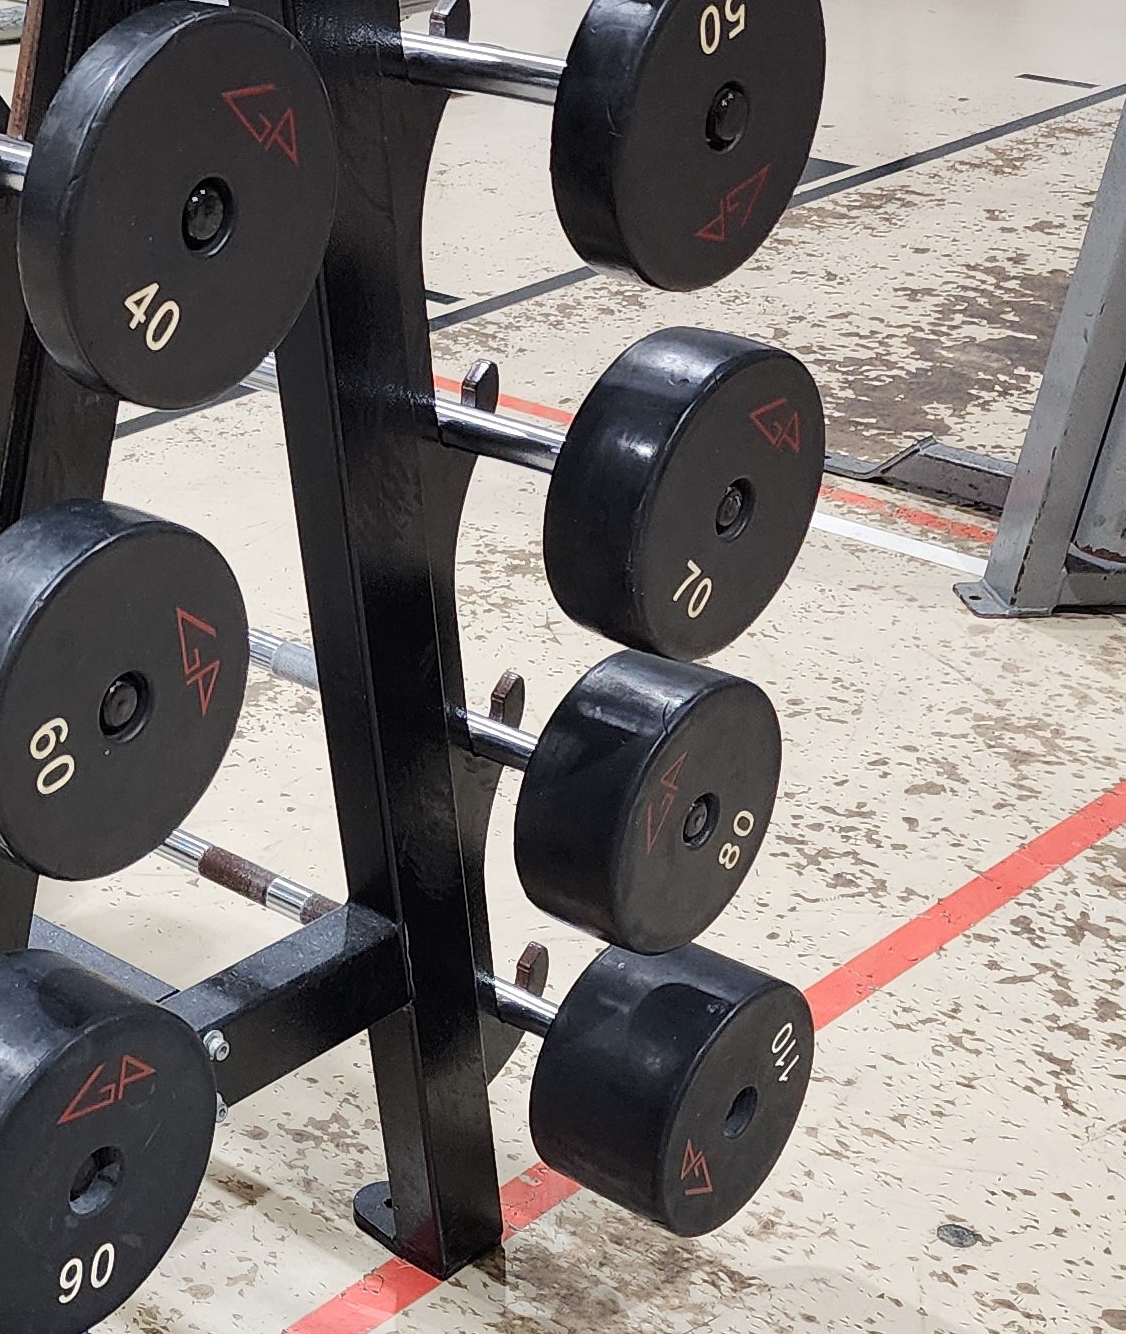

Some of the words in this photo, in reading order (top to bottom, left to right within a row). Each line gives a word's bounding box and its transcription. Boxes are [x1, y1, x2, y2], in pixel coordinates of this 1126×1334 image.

[123, 282, 181, 352] 40
[672, 559, 713, 619] 70
[29, 716, 76, 796] 60
[717, 809, 755, 870] 80
[771, 1022, 801, 1083] 110
[57, 1242, 116, 1305] 90
